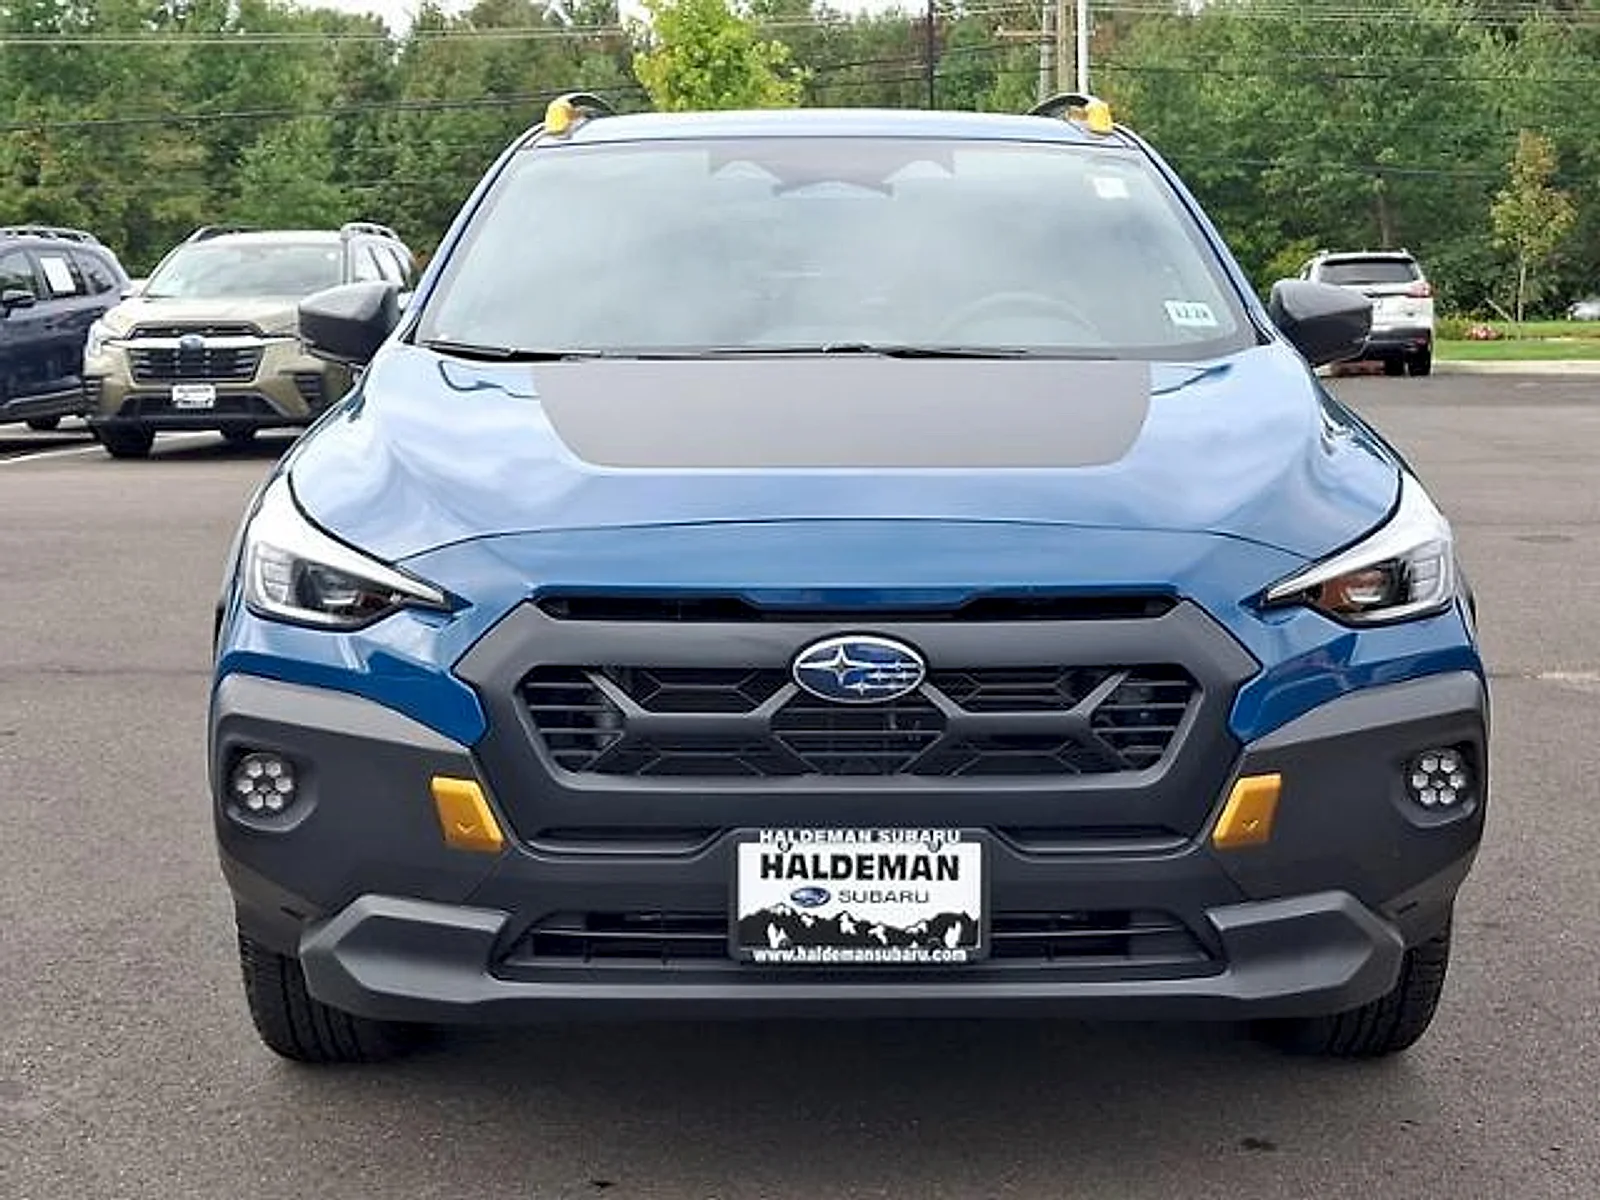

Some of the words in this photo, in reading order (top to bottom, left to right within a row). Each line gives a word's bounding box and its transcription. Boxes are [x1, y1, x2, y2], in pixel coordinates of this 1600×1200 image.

[760, 830, 871, 844] HALDEMAN
[877, 830, 961, 844] SUBARU
[760, 854, 959, 880] HALDEMAN
[838, 890, 929, 904] SUBARU
[753, 948, 967, 962] www.haldemansubaru.com
